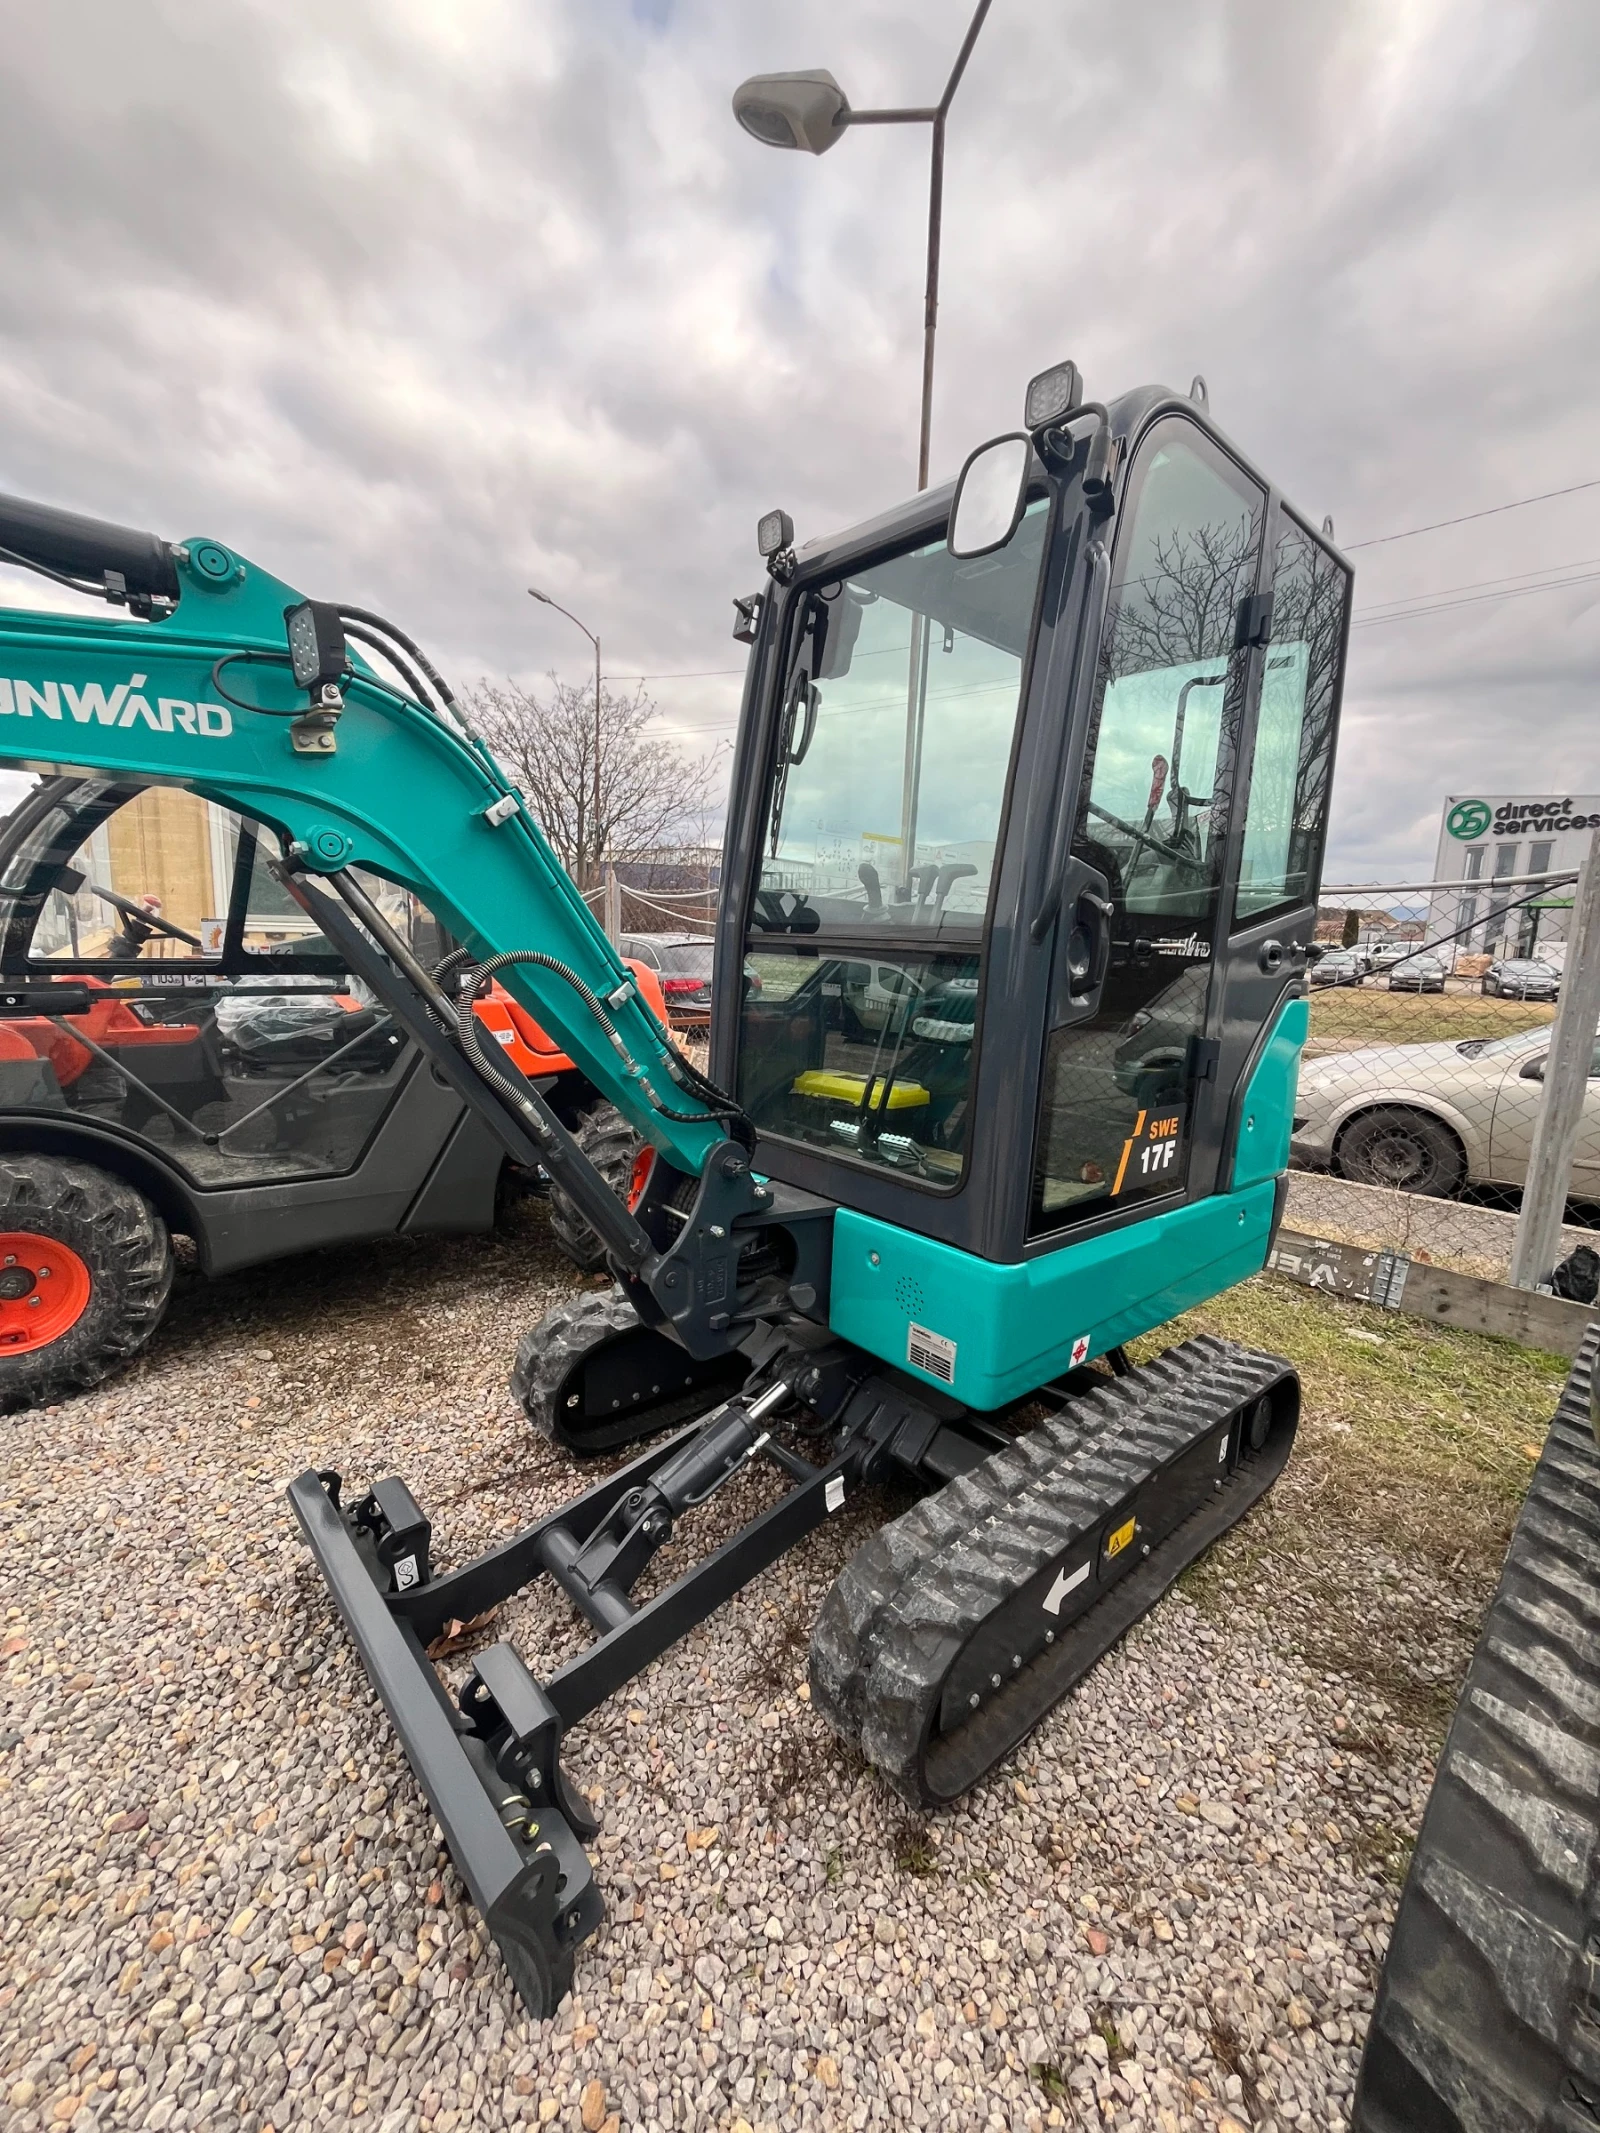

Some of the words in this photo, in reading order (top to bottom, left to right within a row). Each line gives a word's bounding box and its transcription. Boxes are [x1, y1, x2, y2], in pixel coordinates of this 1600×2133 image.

[1494, 797, 1573, 821] direct
[1492, 813, 1600, 836] services
[1149, 1116, 1179, 1140] SWE
[1141, 1139, 1177, 1174] 17F
